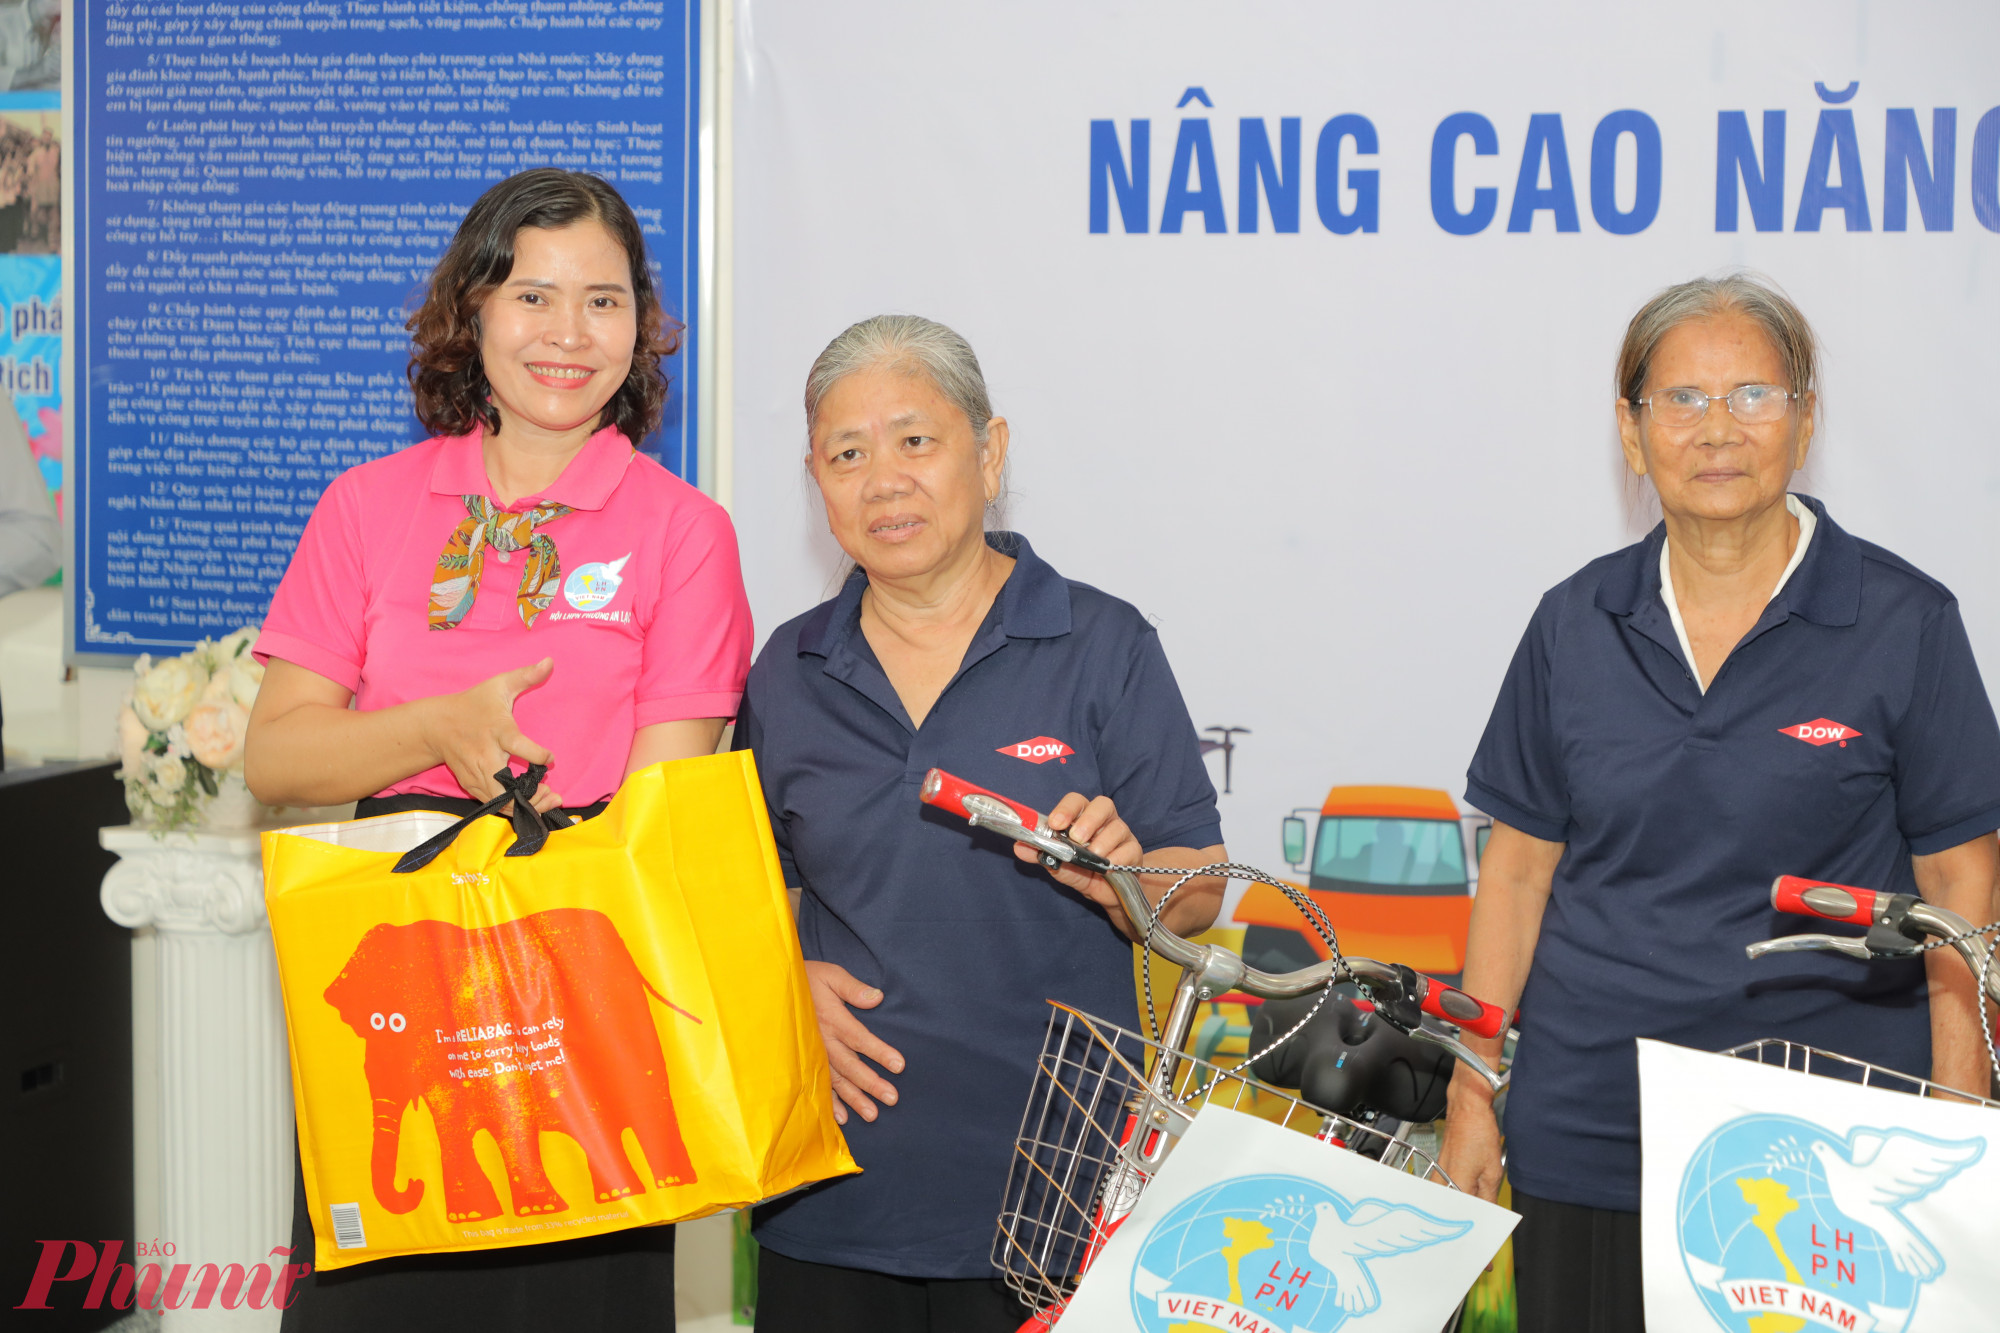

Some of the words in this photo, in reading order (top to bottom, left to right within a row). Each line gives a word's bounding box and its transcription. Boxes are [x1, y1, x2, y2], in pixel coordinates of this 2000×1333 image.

[1088, 86, 1381, 236] NÂNG
[1428, 108, 1664, 237] CAO
[456, 1022, 515, 1043] RELIABAG.
[522, 1025, 540, 1035] can
[542, 1016, 564, 1031] rely
[457, 1052, 469, 1060] me
[470, 1050, 482, 1060] to
[484, 1047, 513, 1058] carry
[468, 1067, 492, 1078] ease.
[545, 1048, 565, 1067] me!
[480, 1229, 495, 1237] bag
[564, 1215, 597, 1227] recycled
[1167, 1298, 1225, 1319] VIET
[1731, 1286, 1789, 1307] VIET
[1800, 1293, 1857, 1332] NAM
